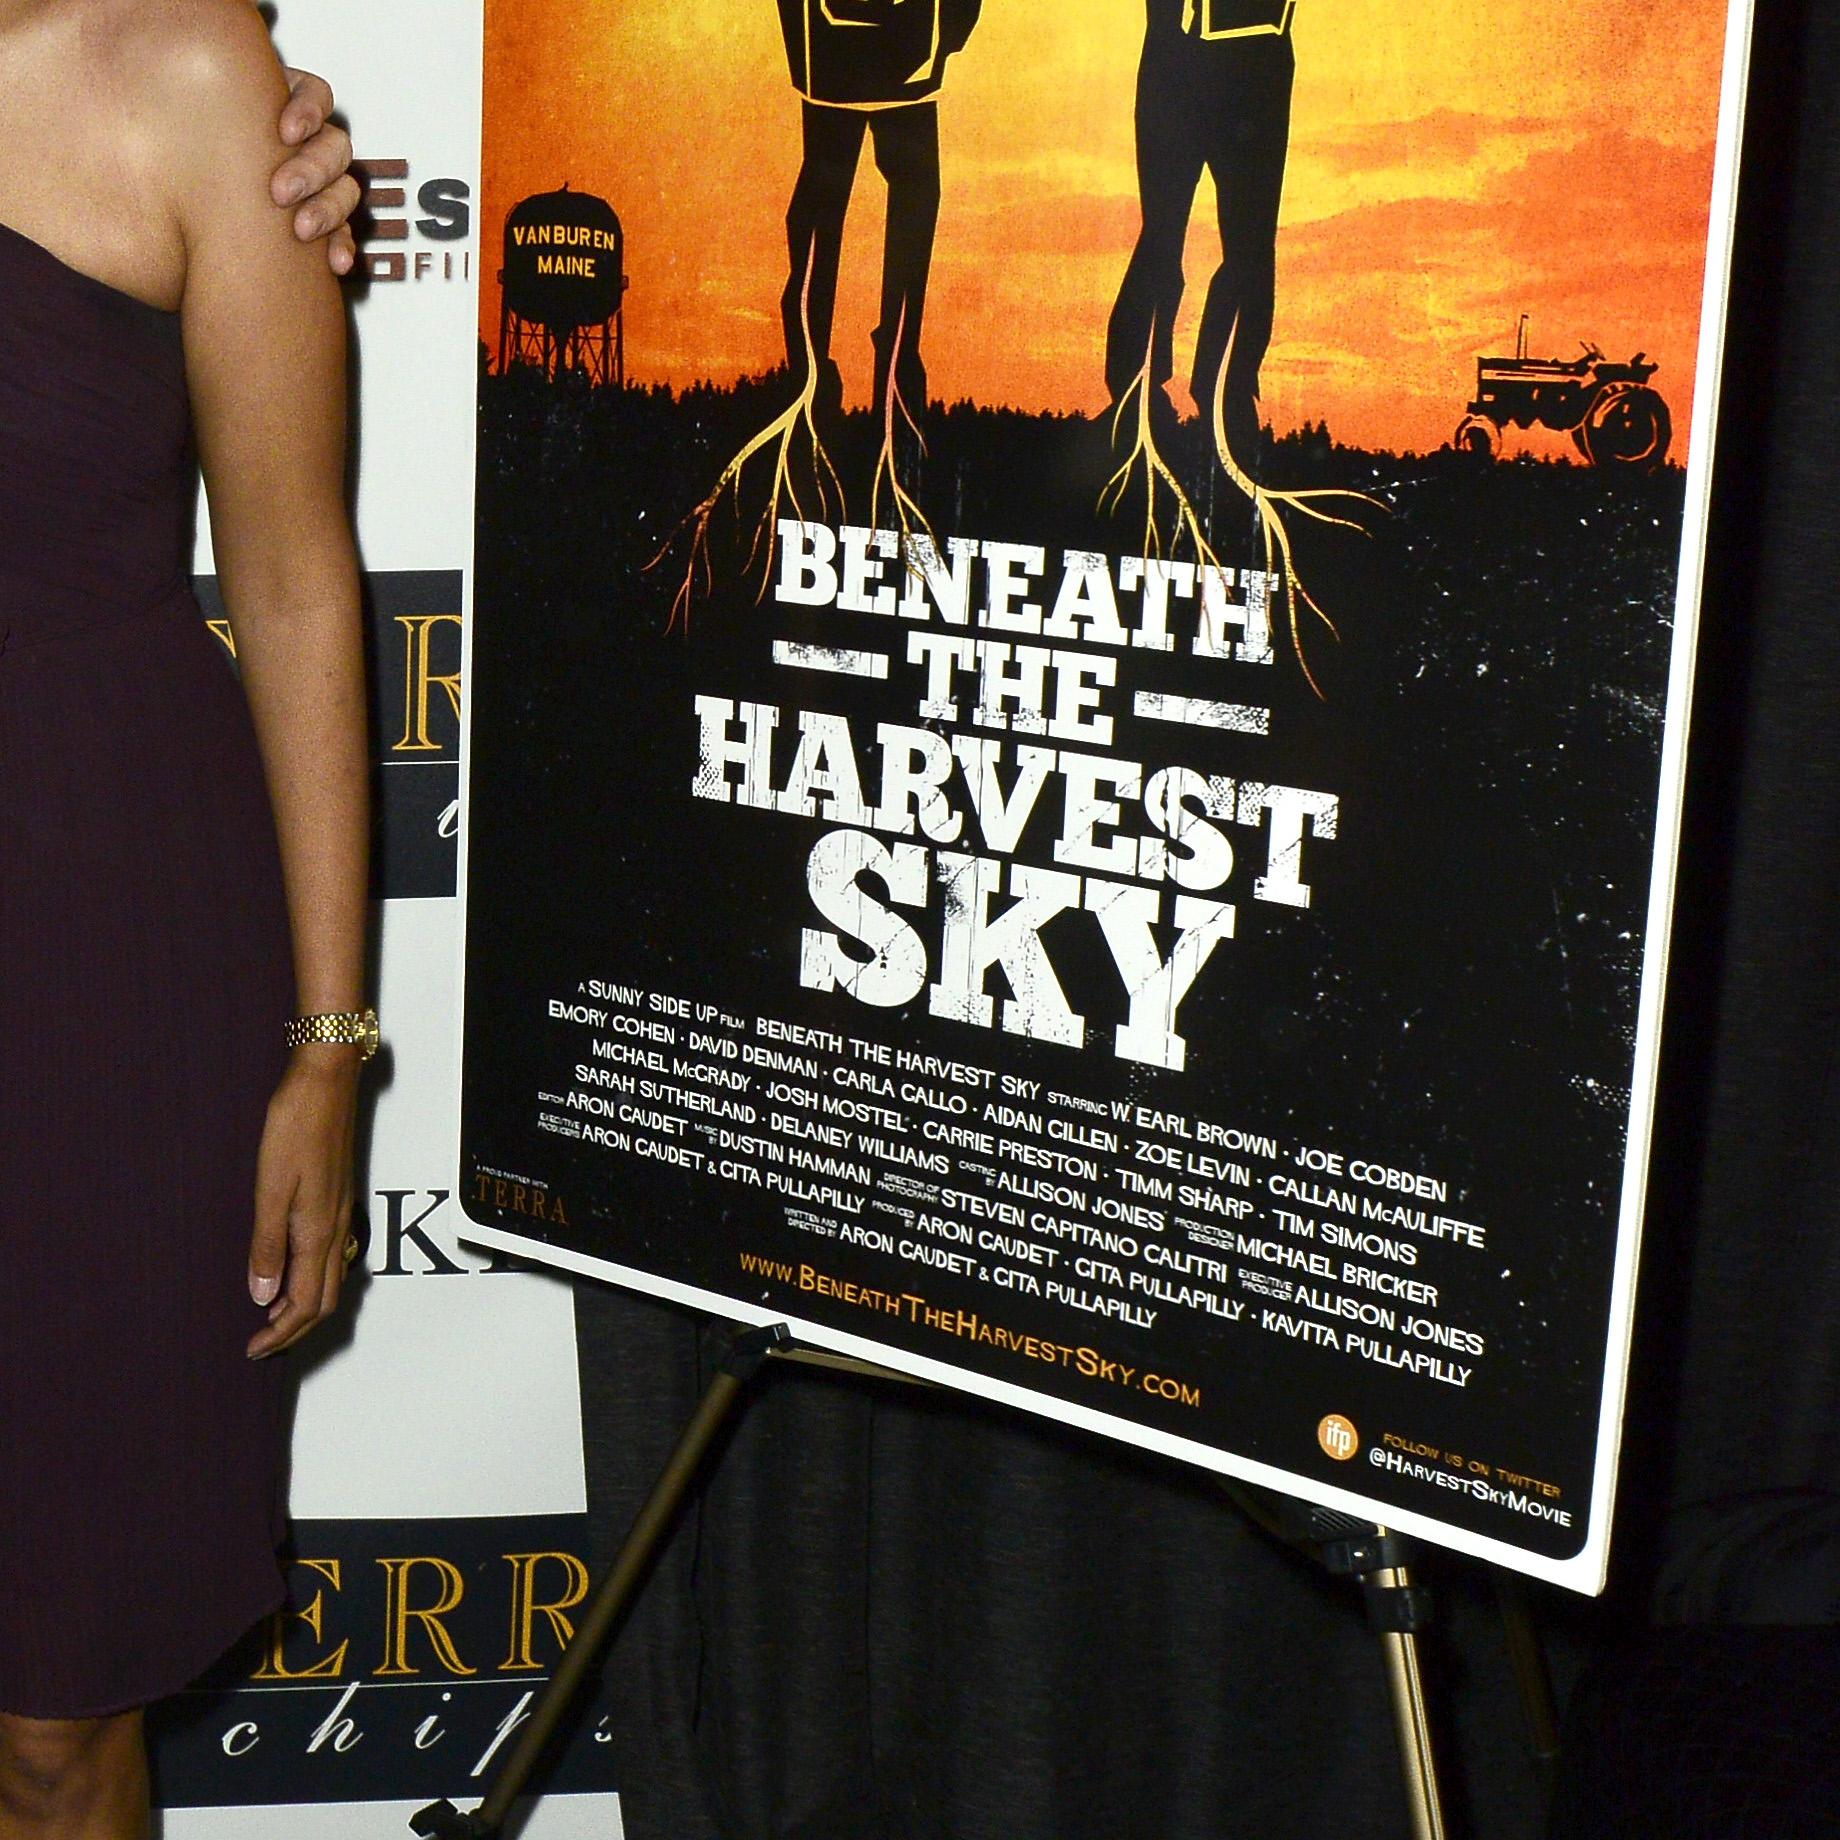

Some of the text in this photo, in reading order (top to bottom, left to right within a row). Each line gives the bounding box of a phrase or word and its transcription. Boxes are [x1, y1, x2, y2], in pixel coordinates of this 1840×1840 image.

[537, 255, 596, 278] MAINE
[774, 517, 1280, 665] BENEATH
[905, 630, 1119, 748] THE
[691, 693, 1339, 910] HARVEST
[799, 828, 1237, 1073] SKY
[565, 1091, 615, 1118] ARON
[577, 982, 586, 994] A
[588, 979, 644, 1007] SUNNY
[649, 993, 691, 1019] SIDE
[695, 1003, 718, 1023] UP
[720, 1013, 745, 1030] FILM
[756, 1016, 843, 1054] BENEATH
[848, 1038, 892, 1066] THE
[896, 1049, 996, 1089] HARVEST
[1000, 1075, 1041, 1100] SKY
[1135, 1107, 1192, 1139] EARL
[1197, 1121, 1277, 1160] BROWN
[1295, 1146, 1344, 1177] JOE
[1349, 1160, 1447, 1203] COBDEN
[548, 999, 608, 1028] EMORY
[612, 1015, 675, 1045] COHEN
[689, 1031, 738, 1059] DAVID
[742, 1044, 818, 1079] DENMAN
[833, 1067, 896, 1098] CARLA
[983, 1103, 1042, 1135] AIDAN
[1135, 1139, 1183, 1170] ZOE
[1187, 1153, 1250, 1187] LEVIN
[1268, 1174, 1356, 1215] CALLAN
[1362, 1197, 1486, 1249] McAULIFFE
[719, 1129, 784, 1163] DUSTIN
[592, 1038, 670, 1074] MICHAEL
[765, 1081, 818, 1110] JOSH
[822, 1094, 908, 1133] MOSTEL
[922, 1120, 995, 1155] CARRIE
[998, 1138, 1097, 1182] PRESTON
[1114, 1168, 1173, 1201] TIMM
[1178, 1185, 1254, 1220] SHARP
[1272, 1209, 1315, 1239] TIM
[1320, 1222, 1418, 1266] SIMONS
[788, 1147, 871, 1186] HAMMAN
[475, 1173, 568, 1225] TERRA
[574, 1064, 635, 1095] SARAH
[639, 1080, 756, 1125] SUTHERLAND
[771, 1112, 853, 1149] DELANEY
[858, 1134, 950, 1175] WILLIAMS
[997, 1171, 1086, 1212] ALLISON
[1091, 1196, 1165, 1232] JONES
[1174, 1216, 1235, 1241] PRODUCTION
[1237, 1234, 1338, 1280] MICHAEL
[1342, 1262, 1438, 1308] BRICKER
[940, 1188, 1025, 1228] STEVEN
[581, 1124, 630, 1152] ARON
[707, 1160, 717, 1176] &
[766, 1172, 865, 1214] PULLAPILLY
[916, 1213, 973, 1245] ARON
[1129, 1271, 1245, 1321] PULLAPILLY
[1261, 1309, 1340, 1350] KAVITA
[1345, 1333, 1472, 1387] PULLAPILLY
[1030, 1213, 1138, 1257] CAPITANO
[839, 1223, 894, 1254] ARON
[978, 1266, 990, 1282] &
[1045, 1280, 1158, 1329] PULLAPILLY
[1143, 1244, 1227, 1283] CALITRI
[1238, 1268, 1293, 1292] EXECUTIVE
[1241, 1280, 1292, 1301] PRODUCER
[1294, 1285, 1395, 1331] ALLISON
[1400, 1315, 1485, 1356] JONES
[1326, 1419, 1351, 1456] ifp
[1383, 1433, 1562, 1497] FOLLOW US ON TWITTER
